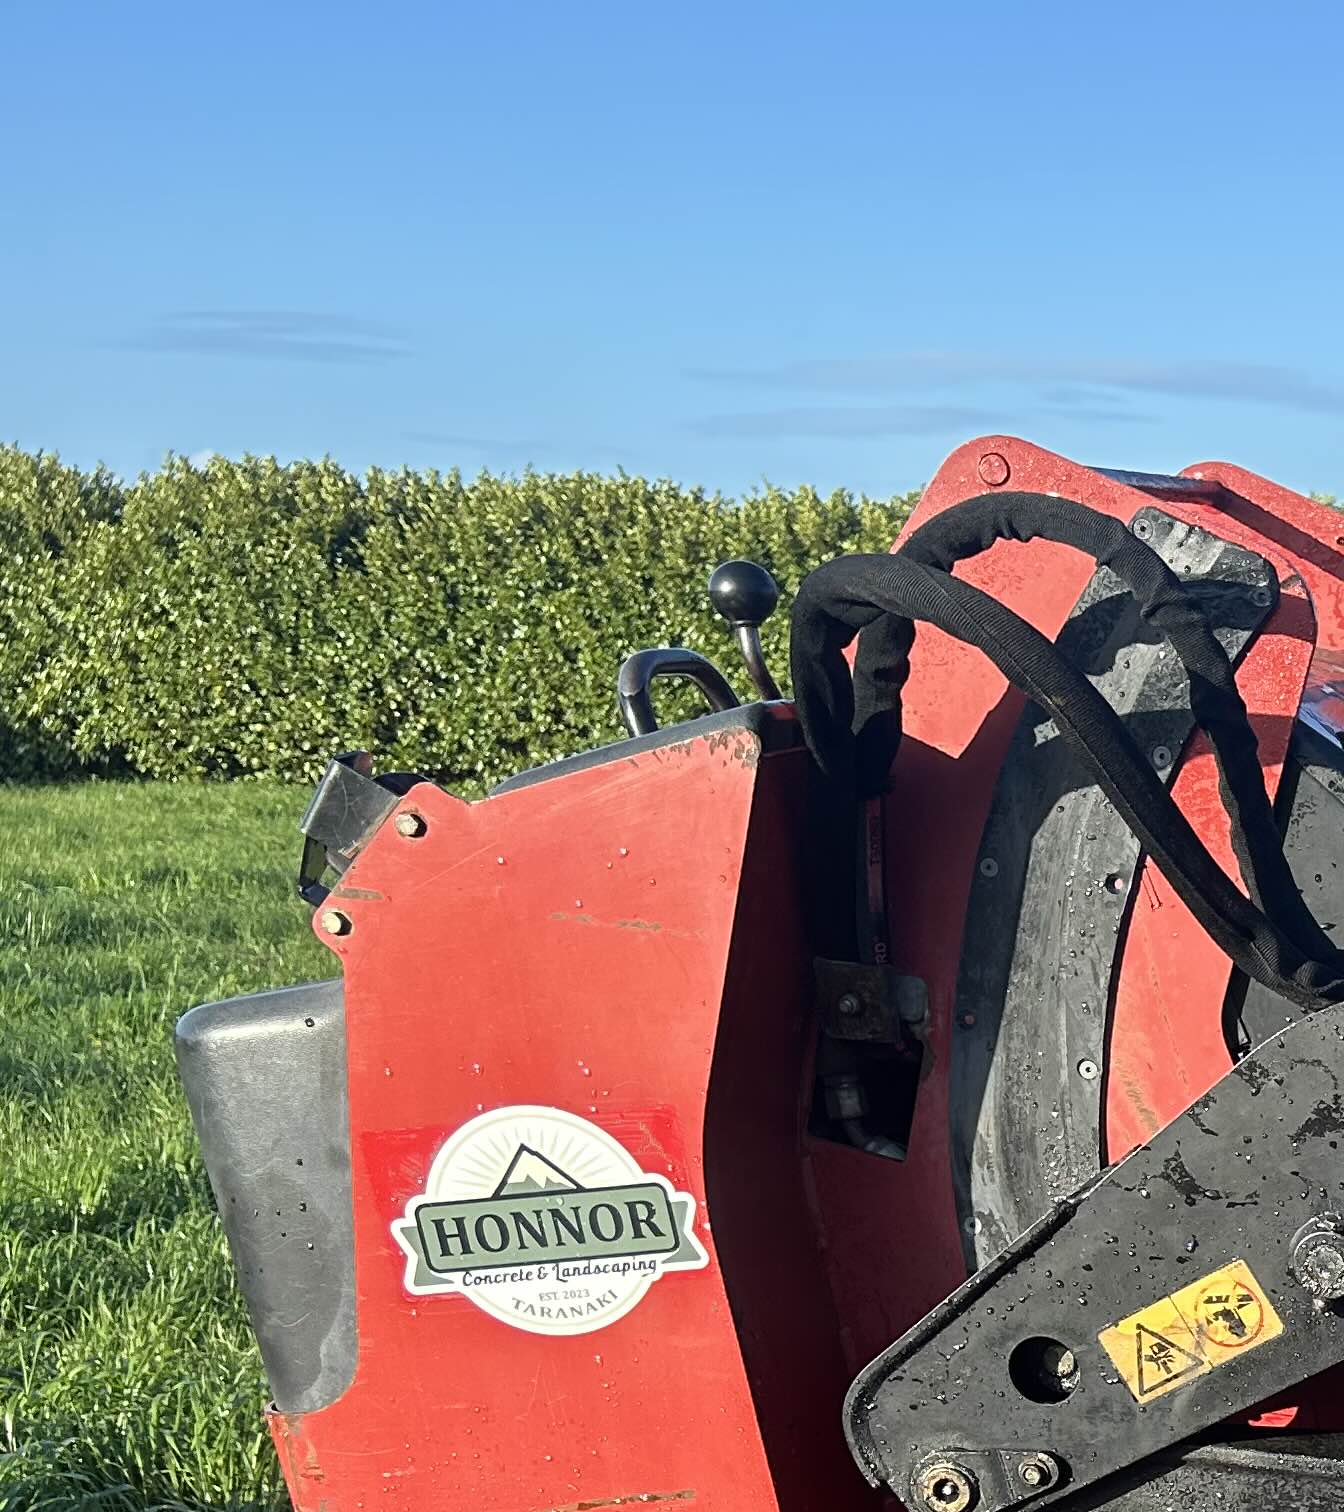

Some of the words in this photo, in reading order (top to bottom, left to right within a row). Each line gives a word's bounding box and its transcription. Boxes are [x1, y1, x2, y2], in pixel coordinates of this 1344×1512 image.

[431, 1199, 667, 1258] HONNOR
[462, 1269, 534, 1287] Concrete
[537, 1266, 549, 1280] &
[552, 1257, 657, 1283] Landscaping
[511, 1289, 618, 1319] TARANAKI
[562, 1288, 590, 1300] 2023
